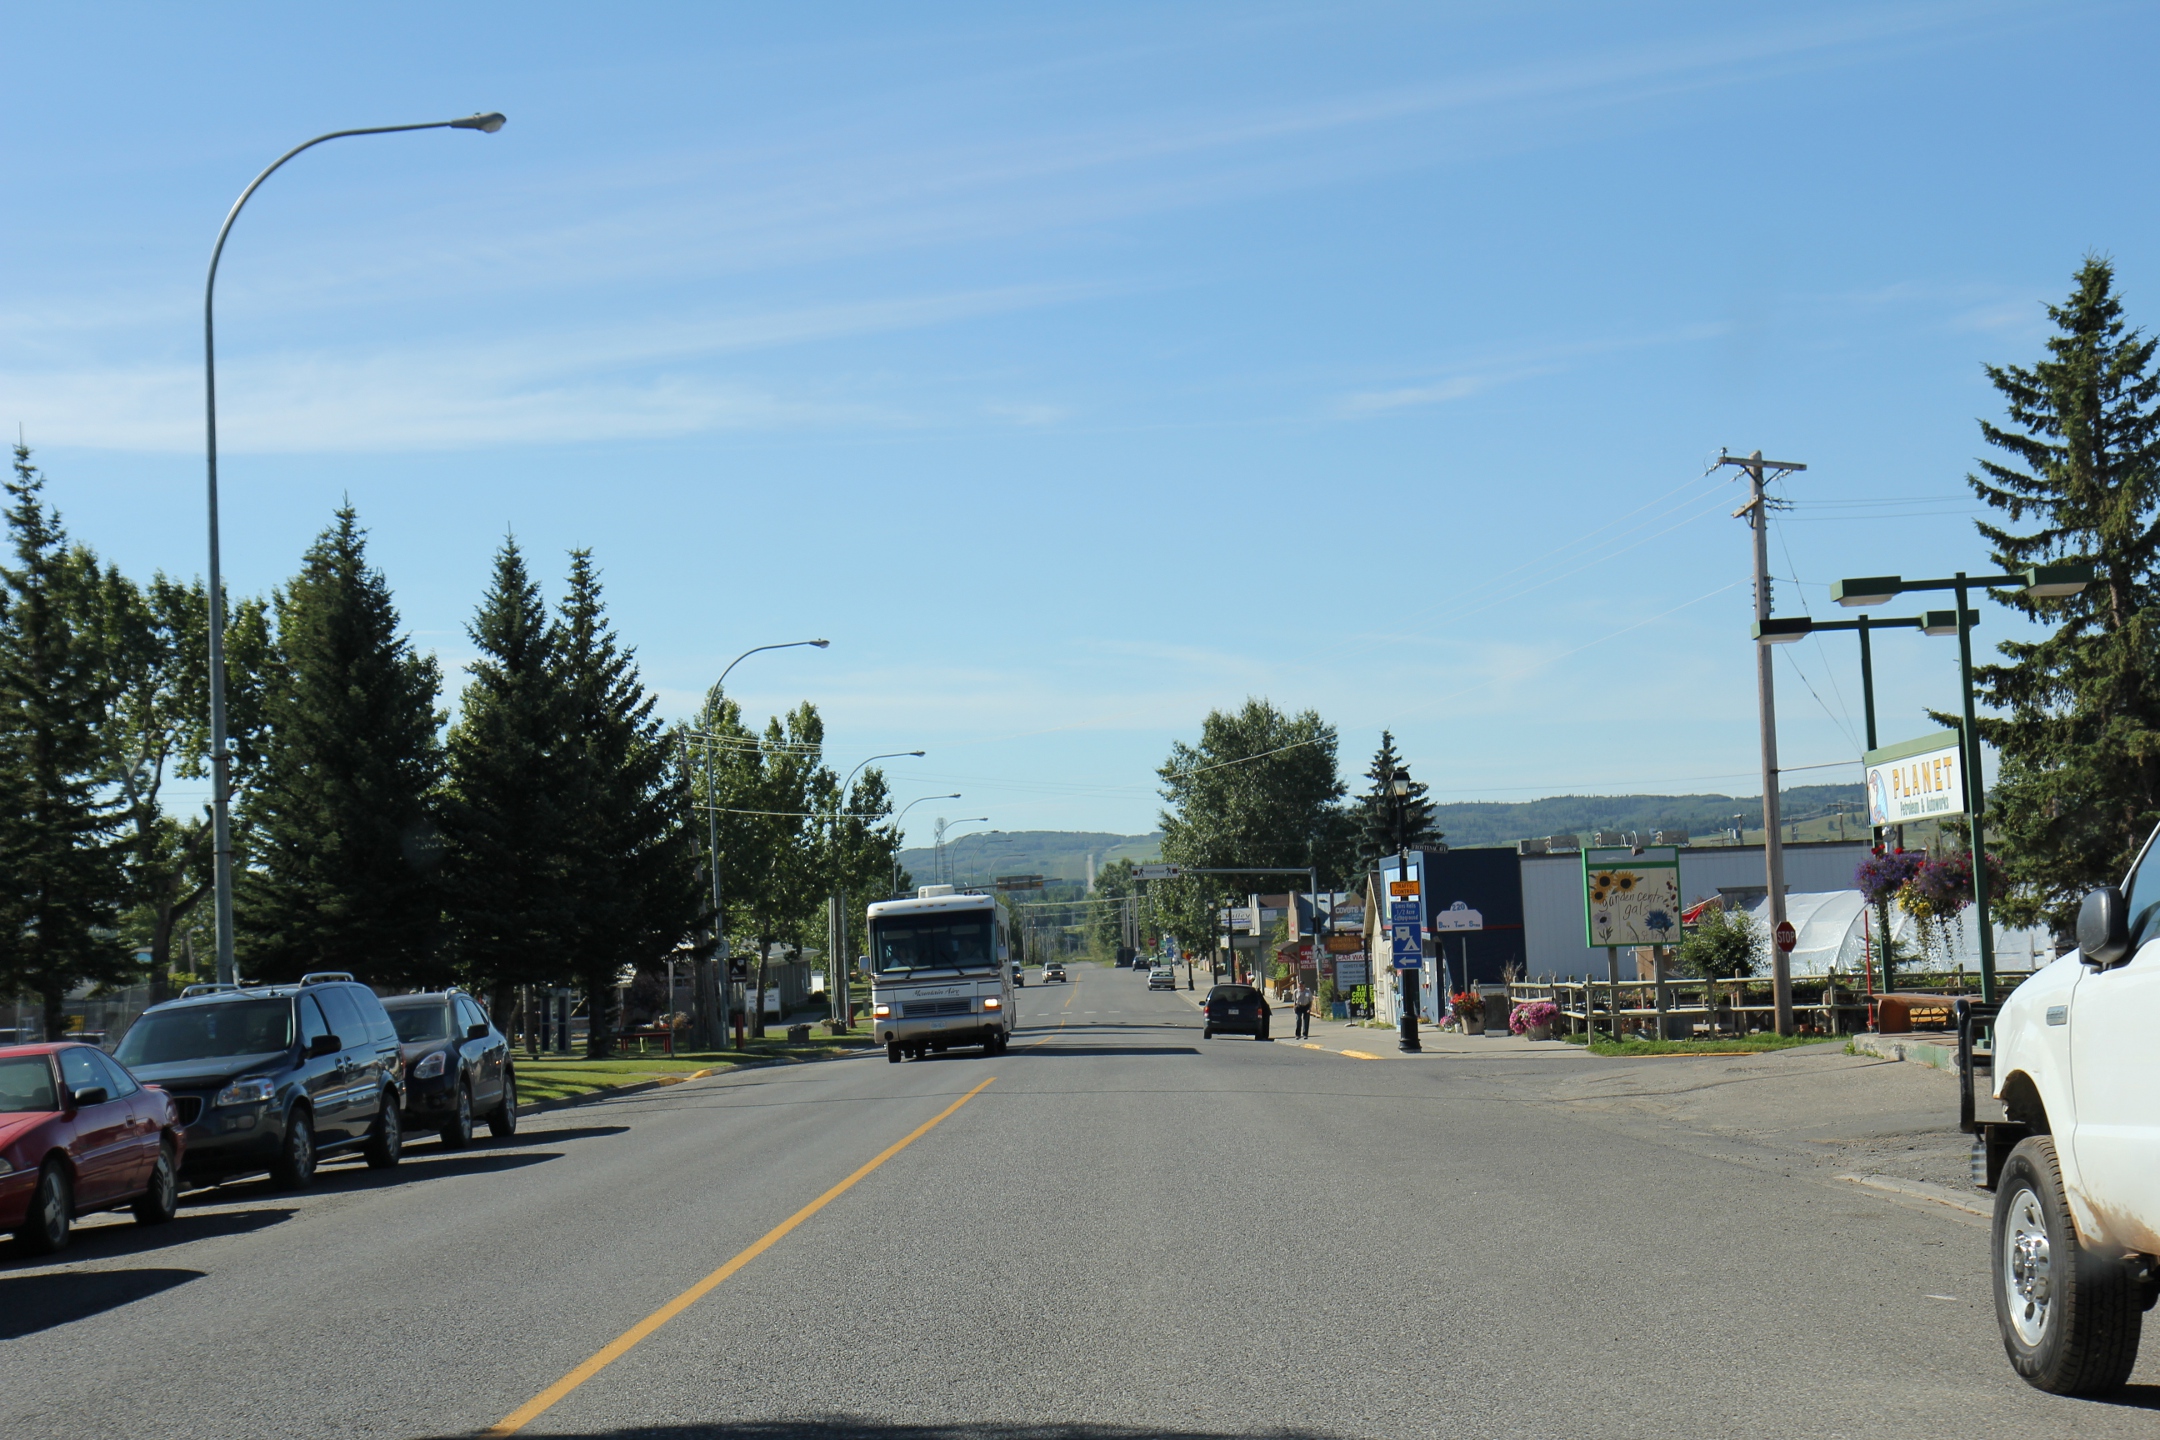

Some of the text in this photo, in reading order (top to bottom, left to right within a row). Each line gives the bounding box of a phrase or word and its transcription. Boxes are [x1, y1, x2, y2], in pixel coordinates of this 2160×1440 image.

[1892, 756, 1952, 799] PLANET
[1900, 799, 1920, 817] Petroleum
[1926, 794, 1949, 812] Autoworks
[1451, 903, 1466, 911] 220
[1599, 890, 1635, 912] garden
[1623, 901, 1651, 920] gals
[1777, 931, 1795, 943] STOP
[913, 989, 944, 997] Mountain
